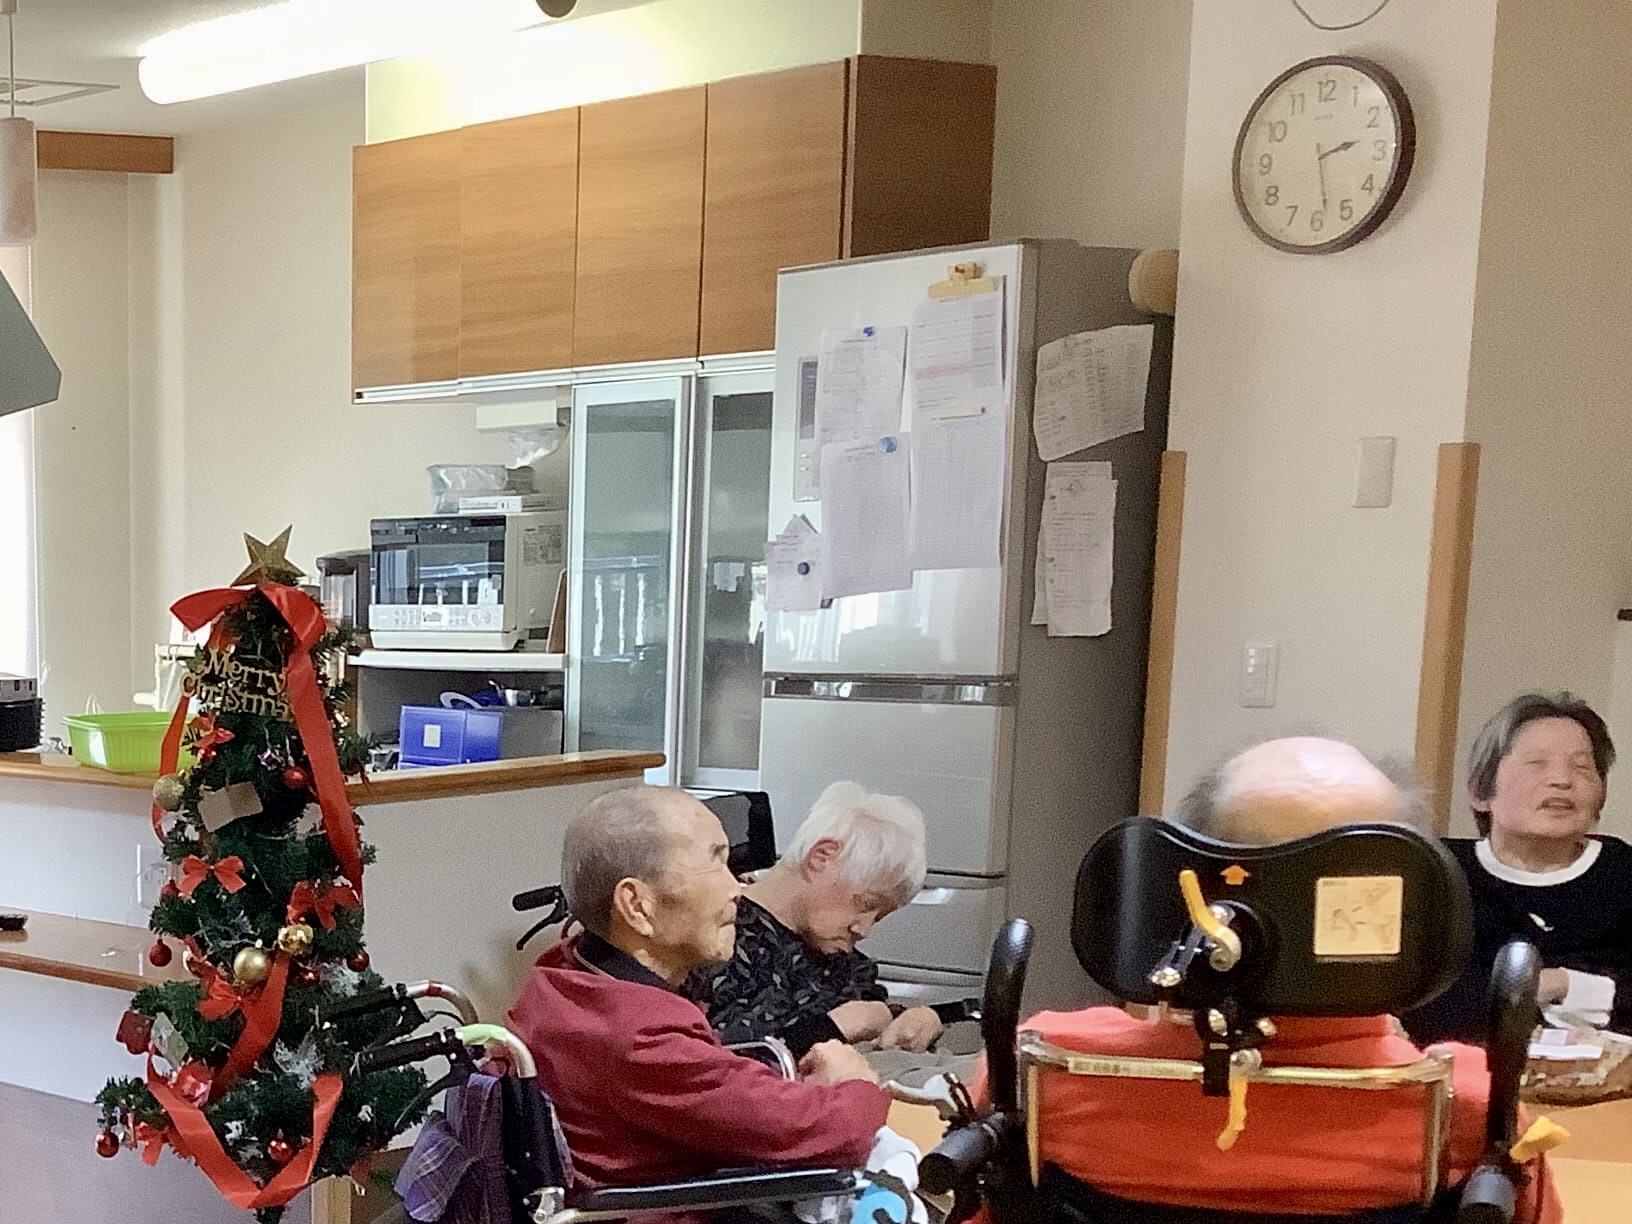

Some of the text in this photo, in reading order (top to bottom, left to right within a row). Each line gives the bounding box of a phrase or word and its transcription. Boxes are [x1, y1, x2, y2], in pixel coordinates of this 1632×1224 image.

[1317, 79, 1337, 103] 12
[1352, 85, 1359, 107] 1
[1290, 93, 1305, 116] 11
[1366, 105, 1380, 129] 2
[1268, 120, 1288, 143] 10
[1372, 139, 1387, 161] 3
[1258, 153, 1273, 176] 9
[1264, 185, 1280, 206] 8
[1360, 173, 1374, 196] 4
[1286, 205, 1299, 227] 7
[1310, 210, 1324, 232] 6
[1339, 199, 1354, 221] 5
[204, 645, 287, 696] Merry
[179, 670, 295, 723] Christma
